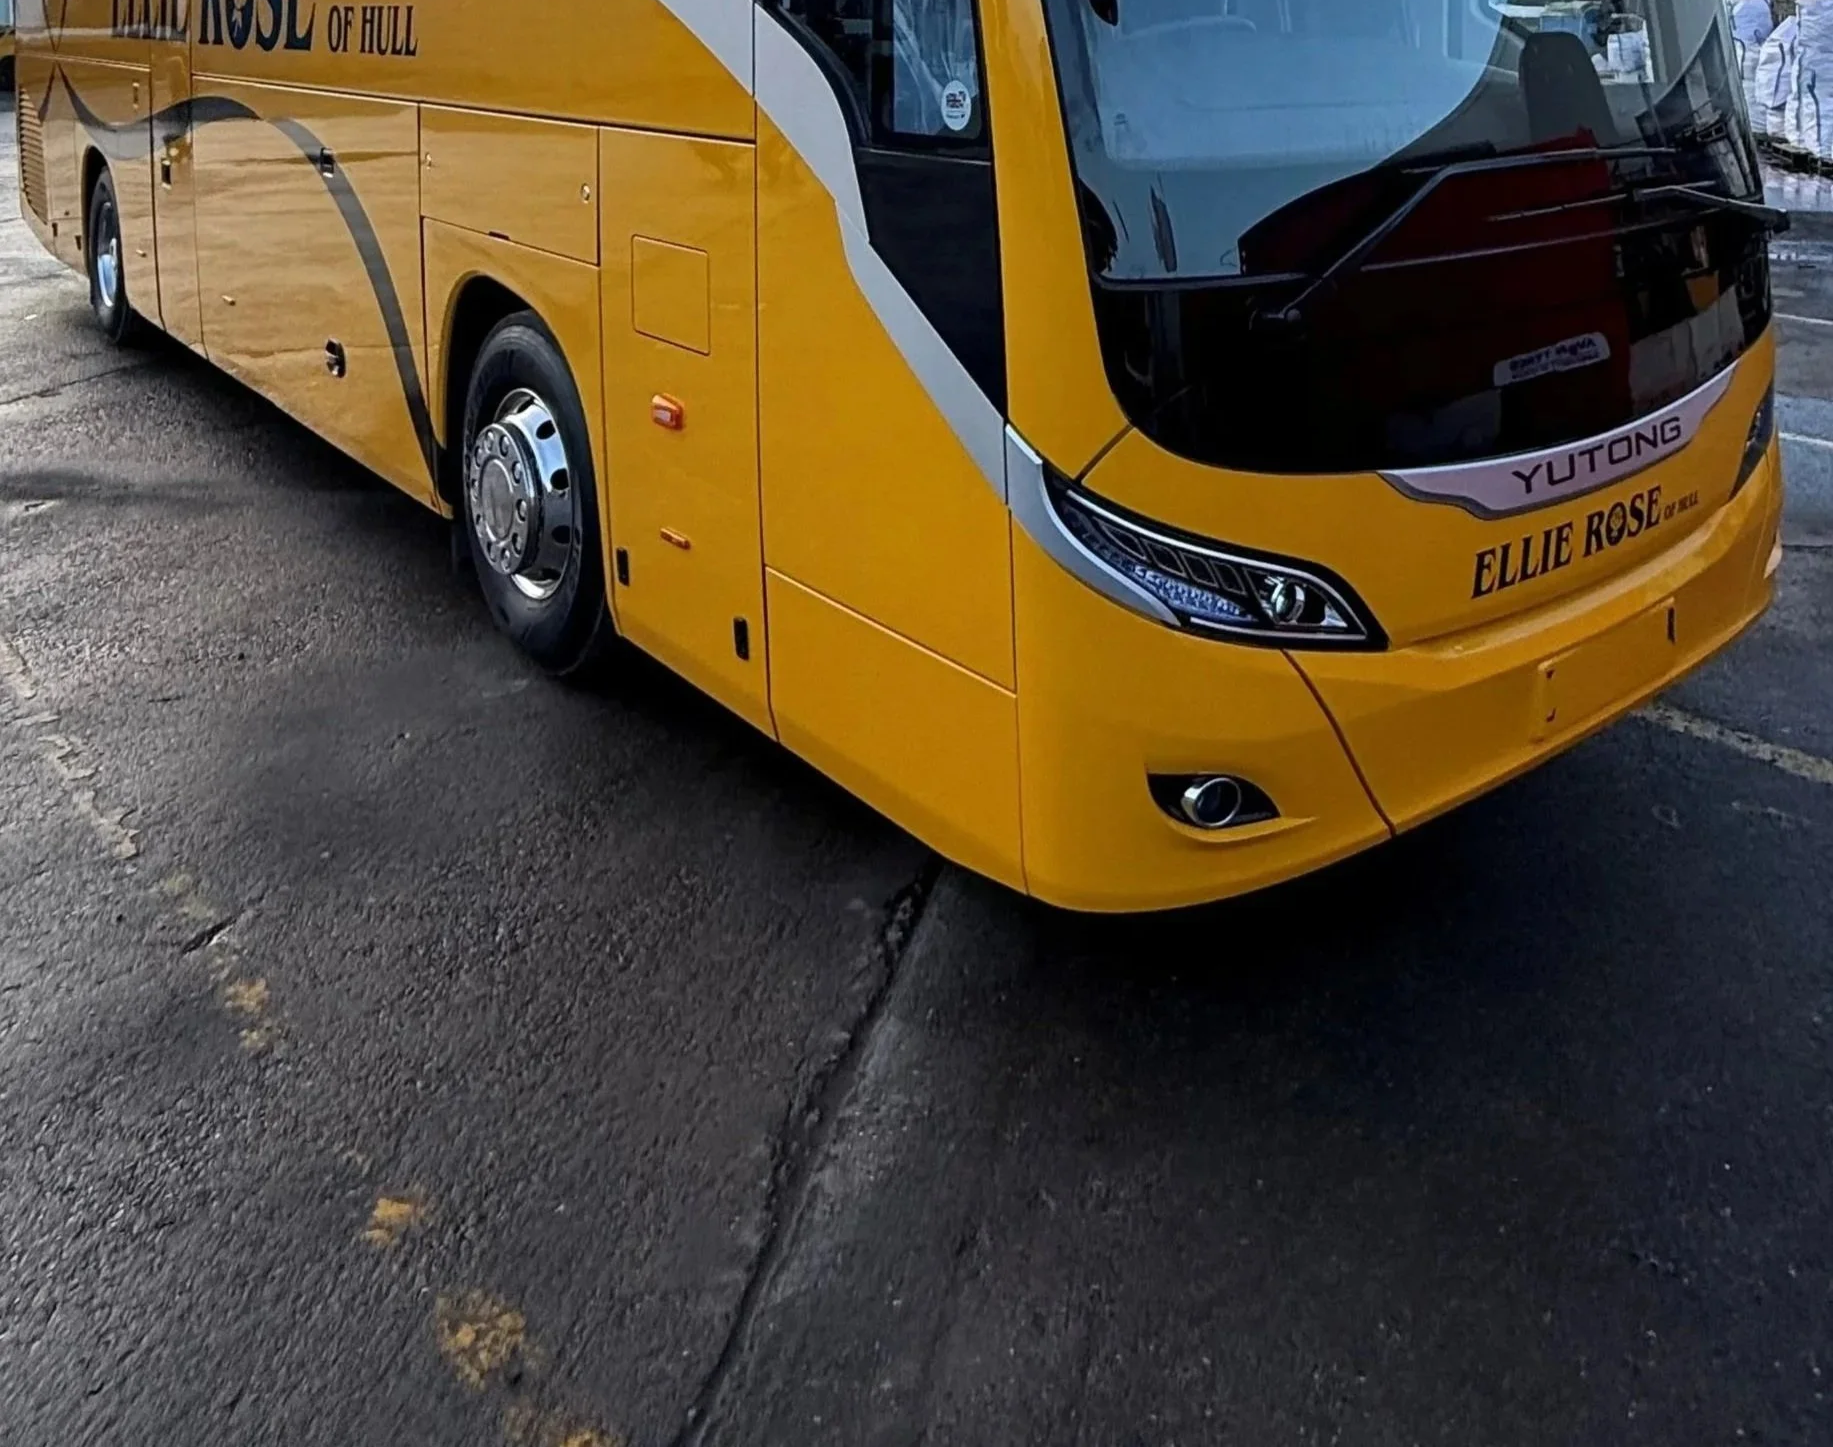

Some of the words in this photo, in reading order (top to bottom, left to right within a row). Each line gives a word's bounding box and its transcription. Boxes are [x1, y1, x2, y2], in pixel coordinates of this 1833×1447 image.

[328, 5, 354, 54] OF
[359, 5, 418, 56] HULL
[1511, 416, 1682, 494] YUTONG
[1471, 520, 1574, 600] ELLIE
[1582, 484, 1663, 558] ROSE
